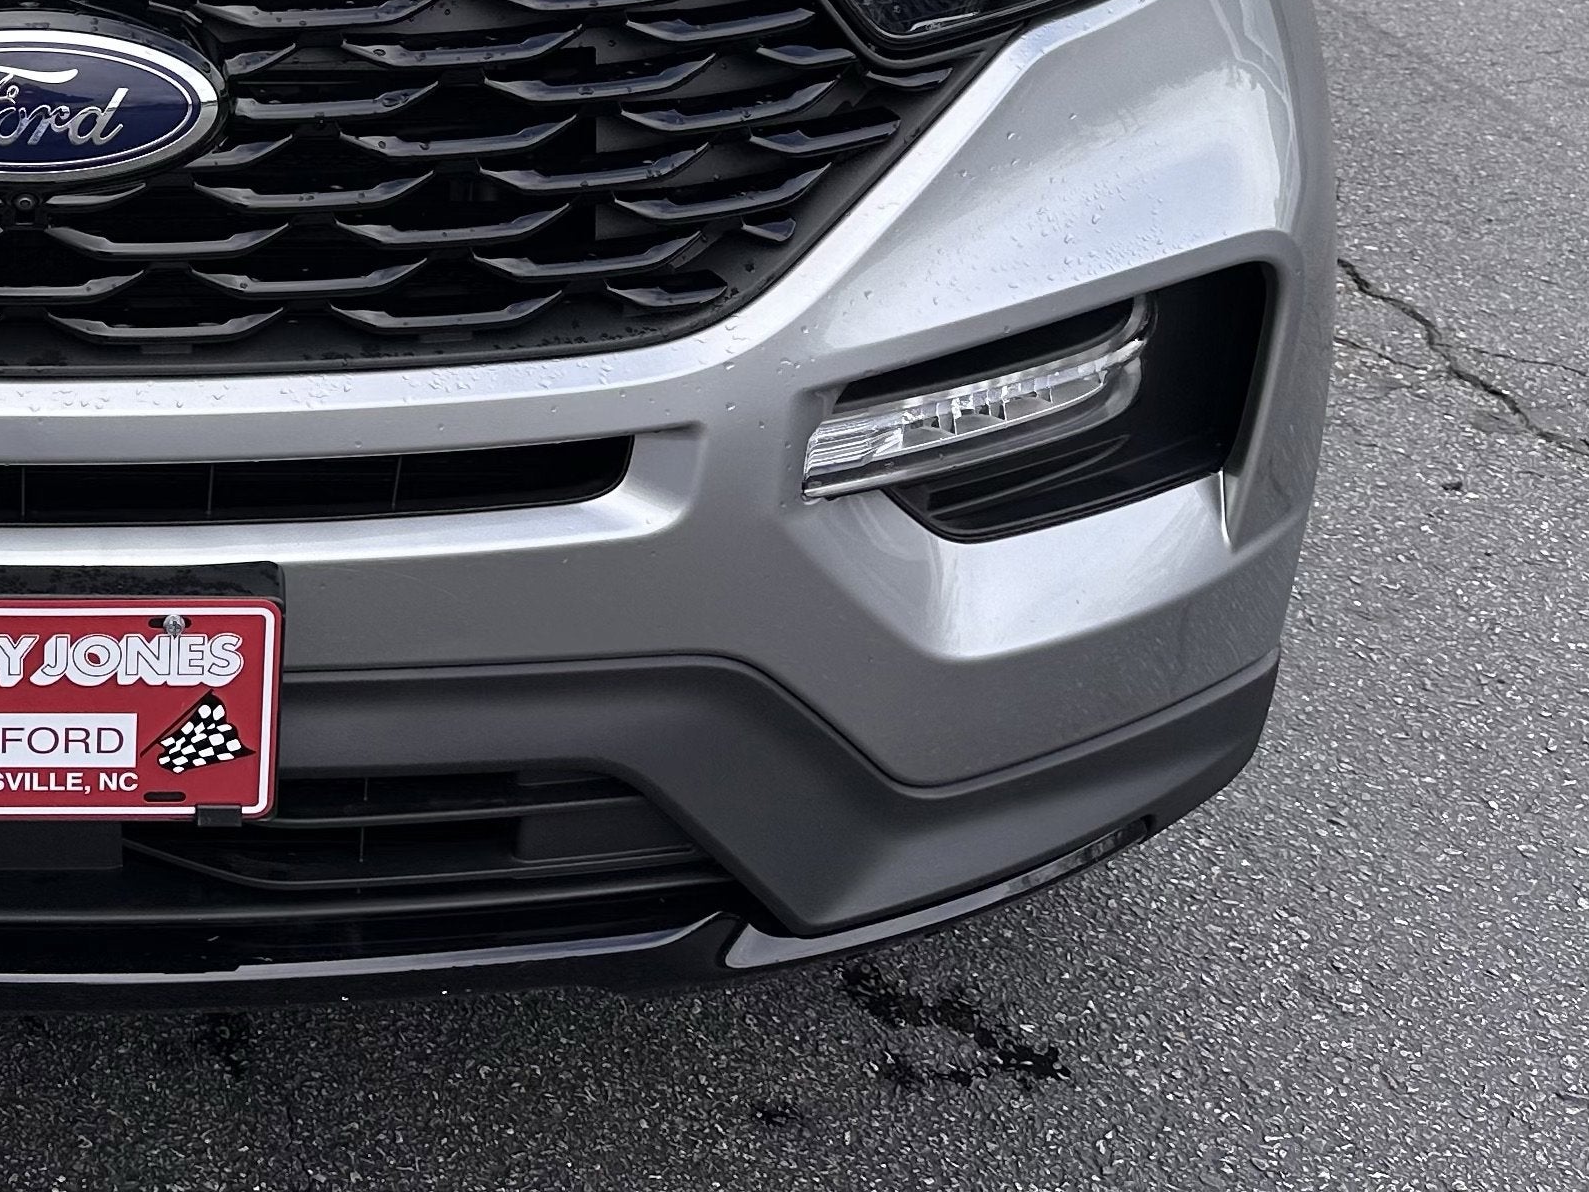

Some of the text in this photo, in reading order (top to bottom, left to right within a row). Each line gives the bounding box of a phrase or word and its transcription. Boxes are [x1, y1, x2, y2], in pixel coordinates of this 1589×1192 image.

[30, 632, 243, 687] JONES
[1, 727, 125, 754] FORD
[99, 772, 139, 791] NC
